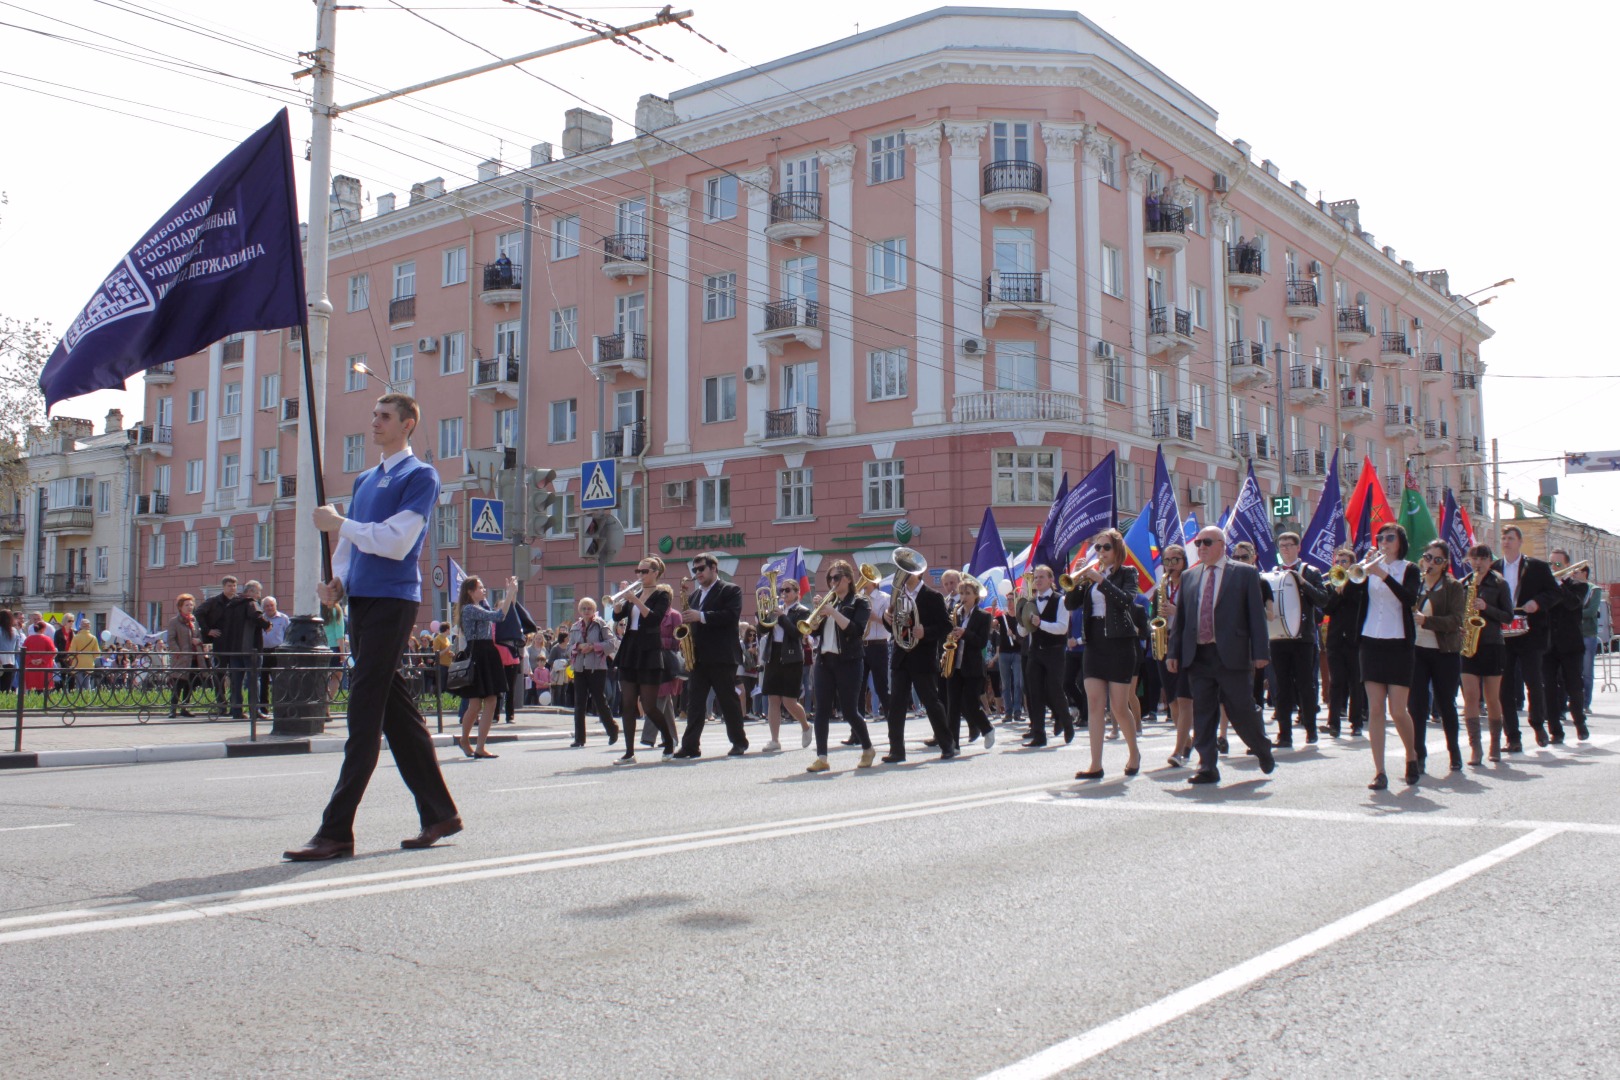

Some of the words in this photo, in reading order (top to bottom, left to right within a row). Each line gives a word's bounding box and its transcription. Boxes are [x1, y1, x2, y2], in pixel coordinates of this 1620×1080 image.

[134, 195, 213, 257] ТАМБОВСКИЙ
[1274, 498, 1291, 515] 23
[676, 532, 746, 551] СБЕРБАНК
